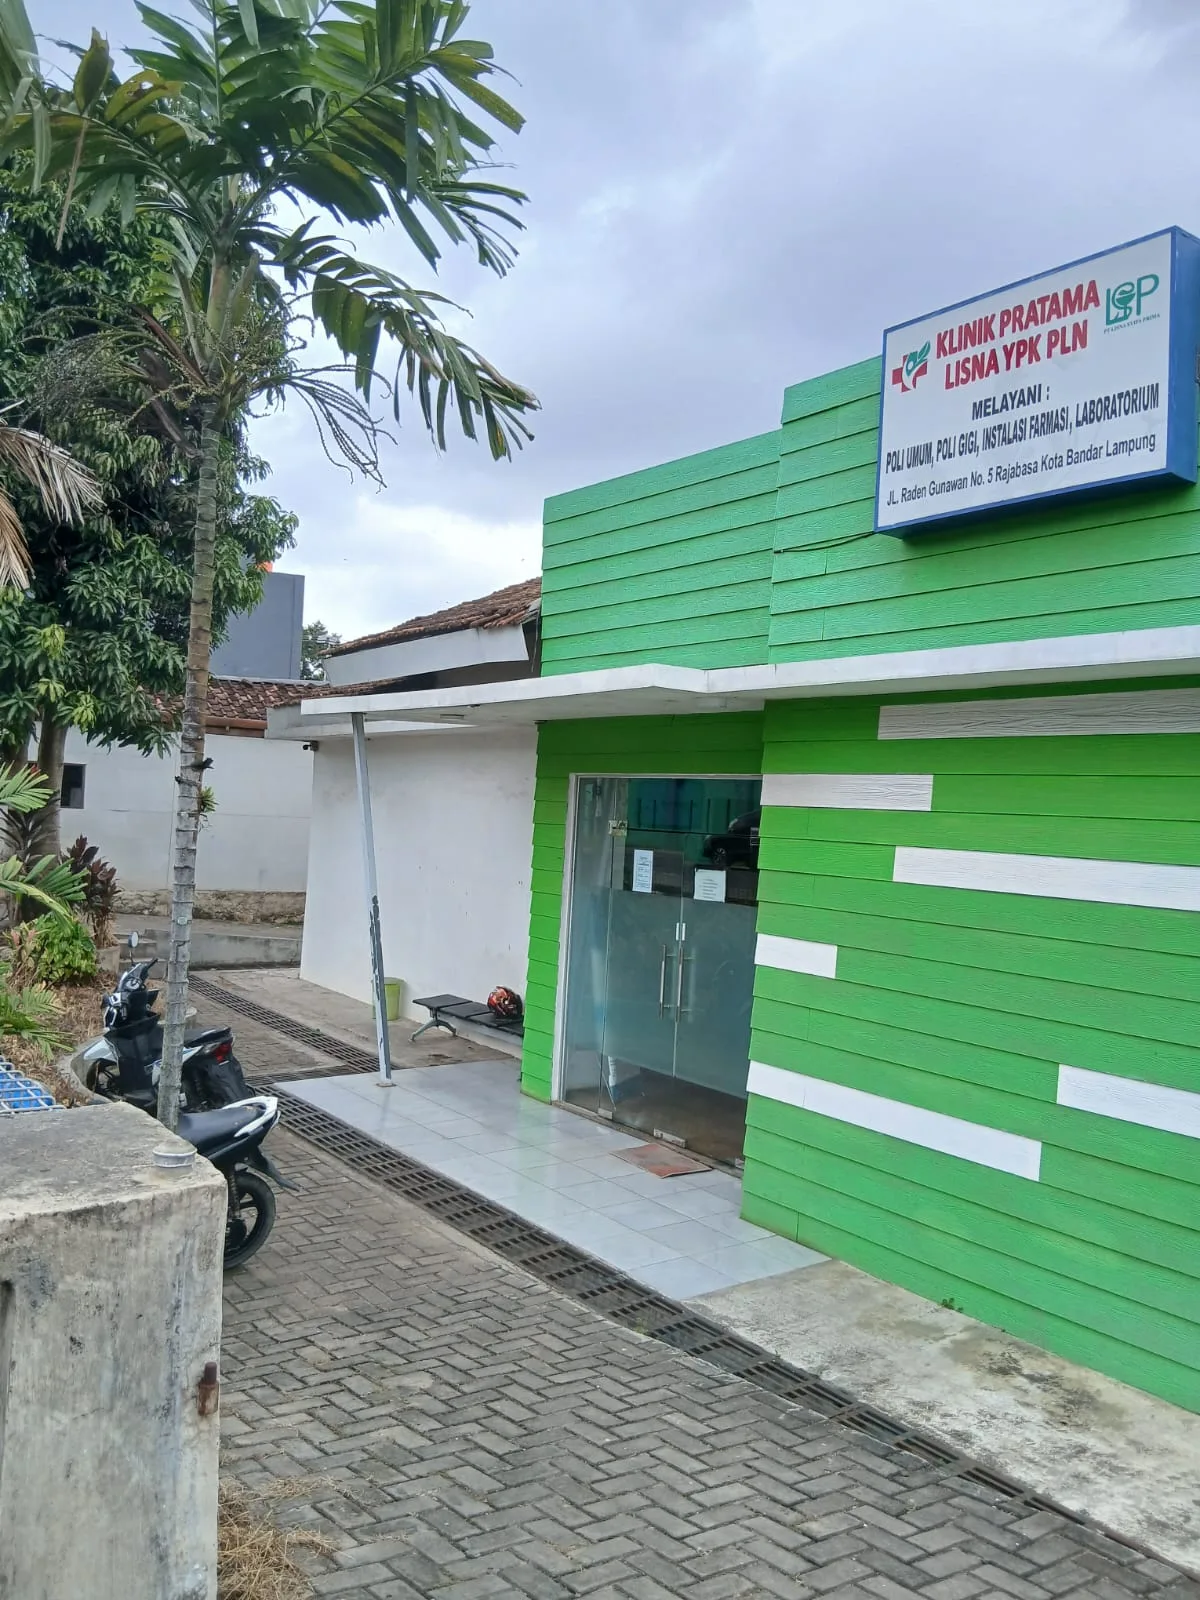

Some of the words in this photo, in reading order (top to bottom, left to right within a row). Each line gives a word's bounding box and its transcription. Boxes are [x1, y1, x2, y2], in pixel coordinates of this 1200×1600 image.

[936, 313, 996, 359] KLINIK
[999, 279, 1101, 338] PRATAMA
[944, 348, 1000, 390] LISNA
[1002, 333, 1042, 372] YPK
[1046, 319, 1088, 359] PLN
[885, 448, 905, 474] POLI
[906, 441, 934, 469] UMUM,
[936, 435, 957, 463] POLI
[958, 429, 980, 458] GIGI,
[981, 416, 1027, 451] INSTALASI
[1028, 405, 1073, 440] FARMASI,
[1075, 382, 1160, 428] LABORATORIUM
[972, 383, 1042, 421] MELAYANI
[886, 490, 899, 506] JL.
[900, 484, 927, 503] Raden
[928, 475, 968, 497] Gunawan
[969, 470, 985, 488] No.
[987, 467, 994, 484] 5
[994, 460, 1039, 484] Rajabasa
[1040, 453, 1064, 472] Kota
[1066, 443, 1104, 466] Bandar
[1105, 433, 1156, 457] Lampung
